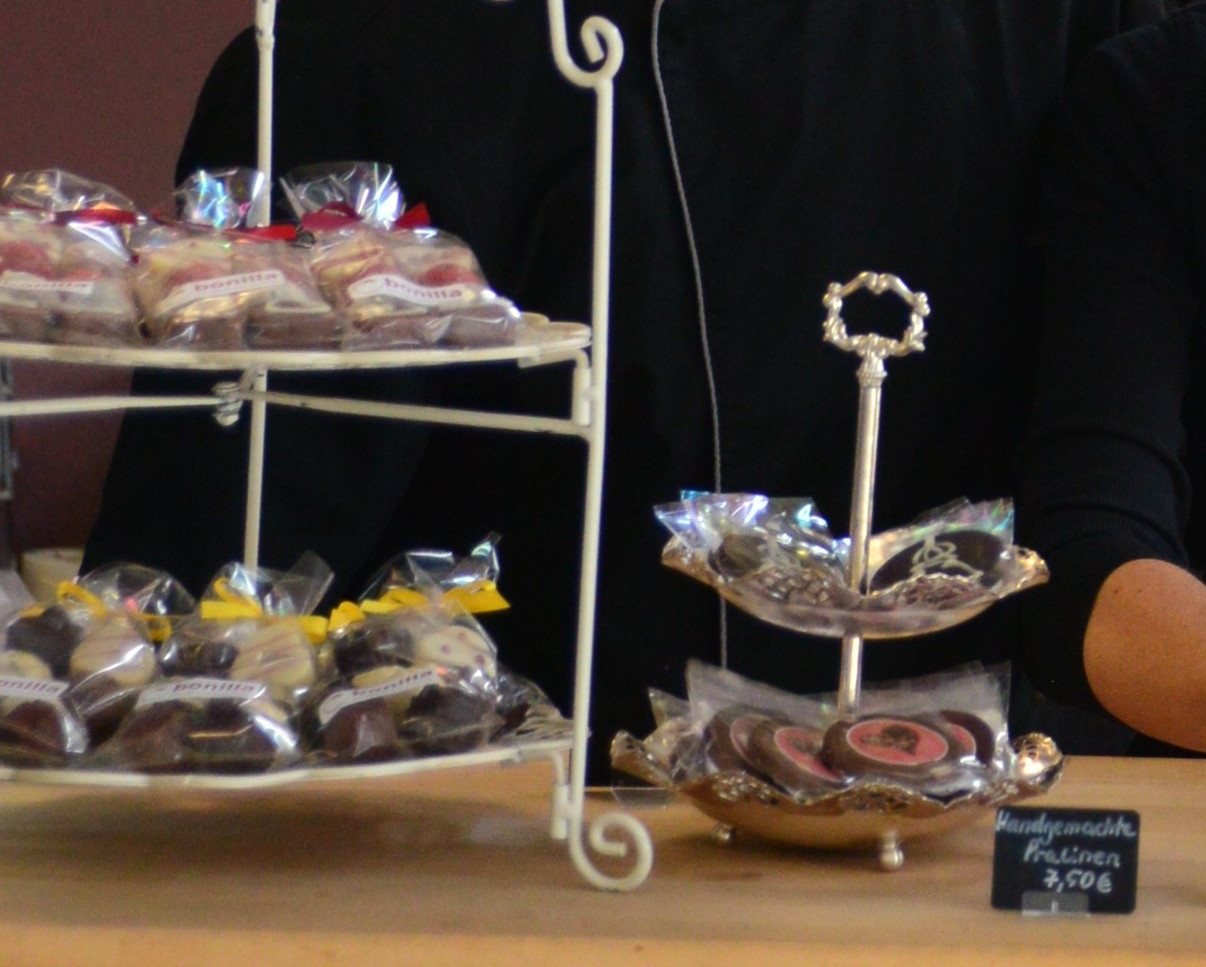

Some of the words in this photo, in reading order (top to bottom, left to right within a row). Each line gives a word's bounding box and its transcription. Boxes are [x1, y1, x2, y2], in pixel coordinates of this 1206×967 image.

[194, 273, 278, 292] bonilla
[384, 277, 463, 299] bonilla
[0, 679, 60, 693] onilla
[173, 683, 256, 693] bonilla
[995, 809, 1136, 846] Handgemachte
[1023, 837, 1121, 869] Pralinen
